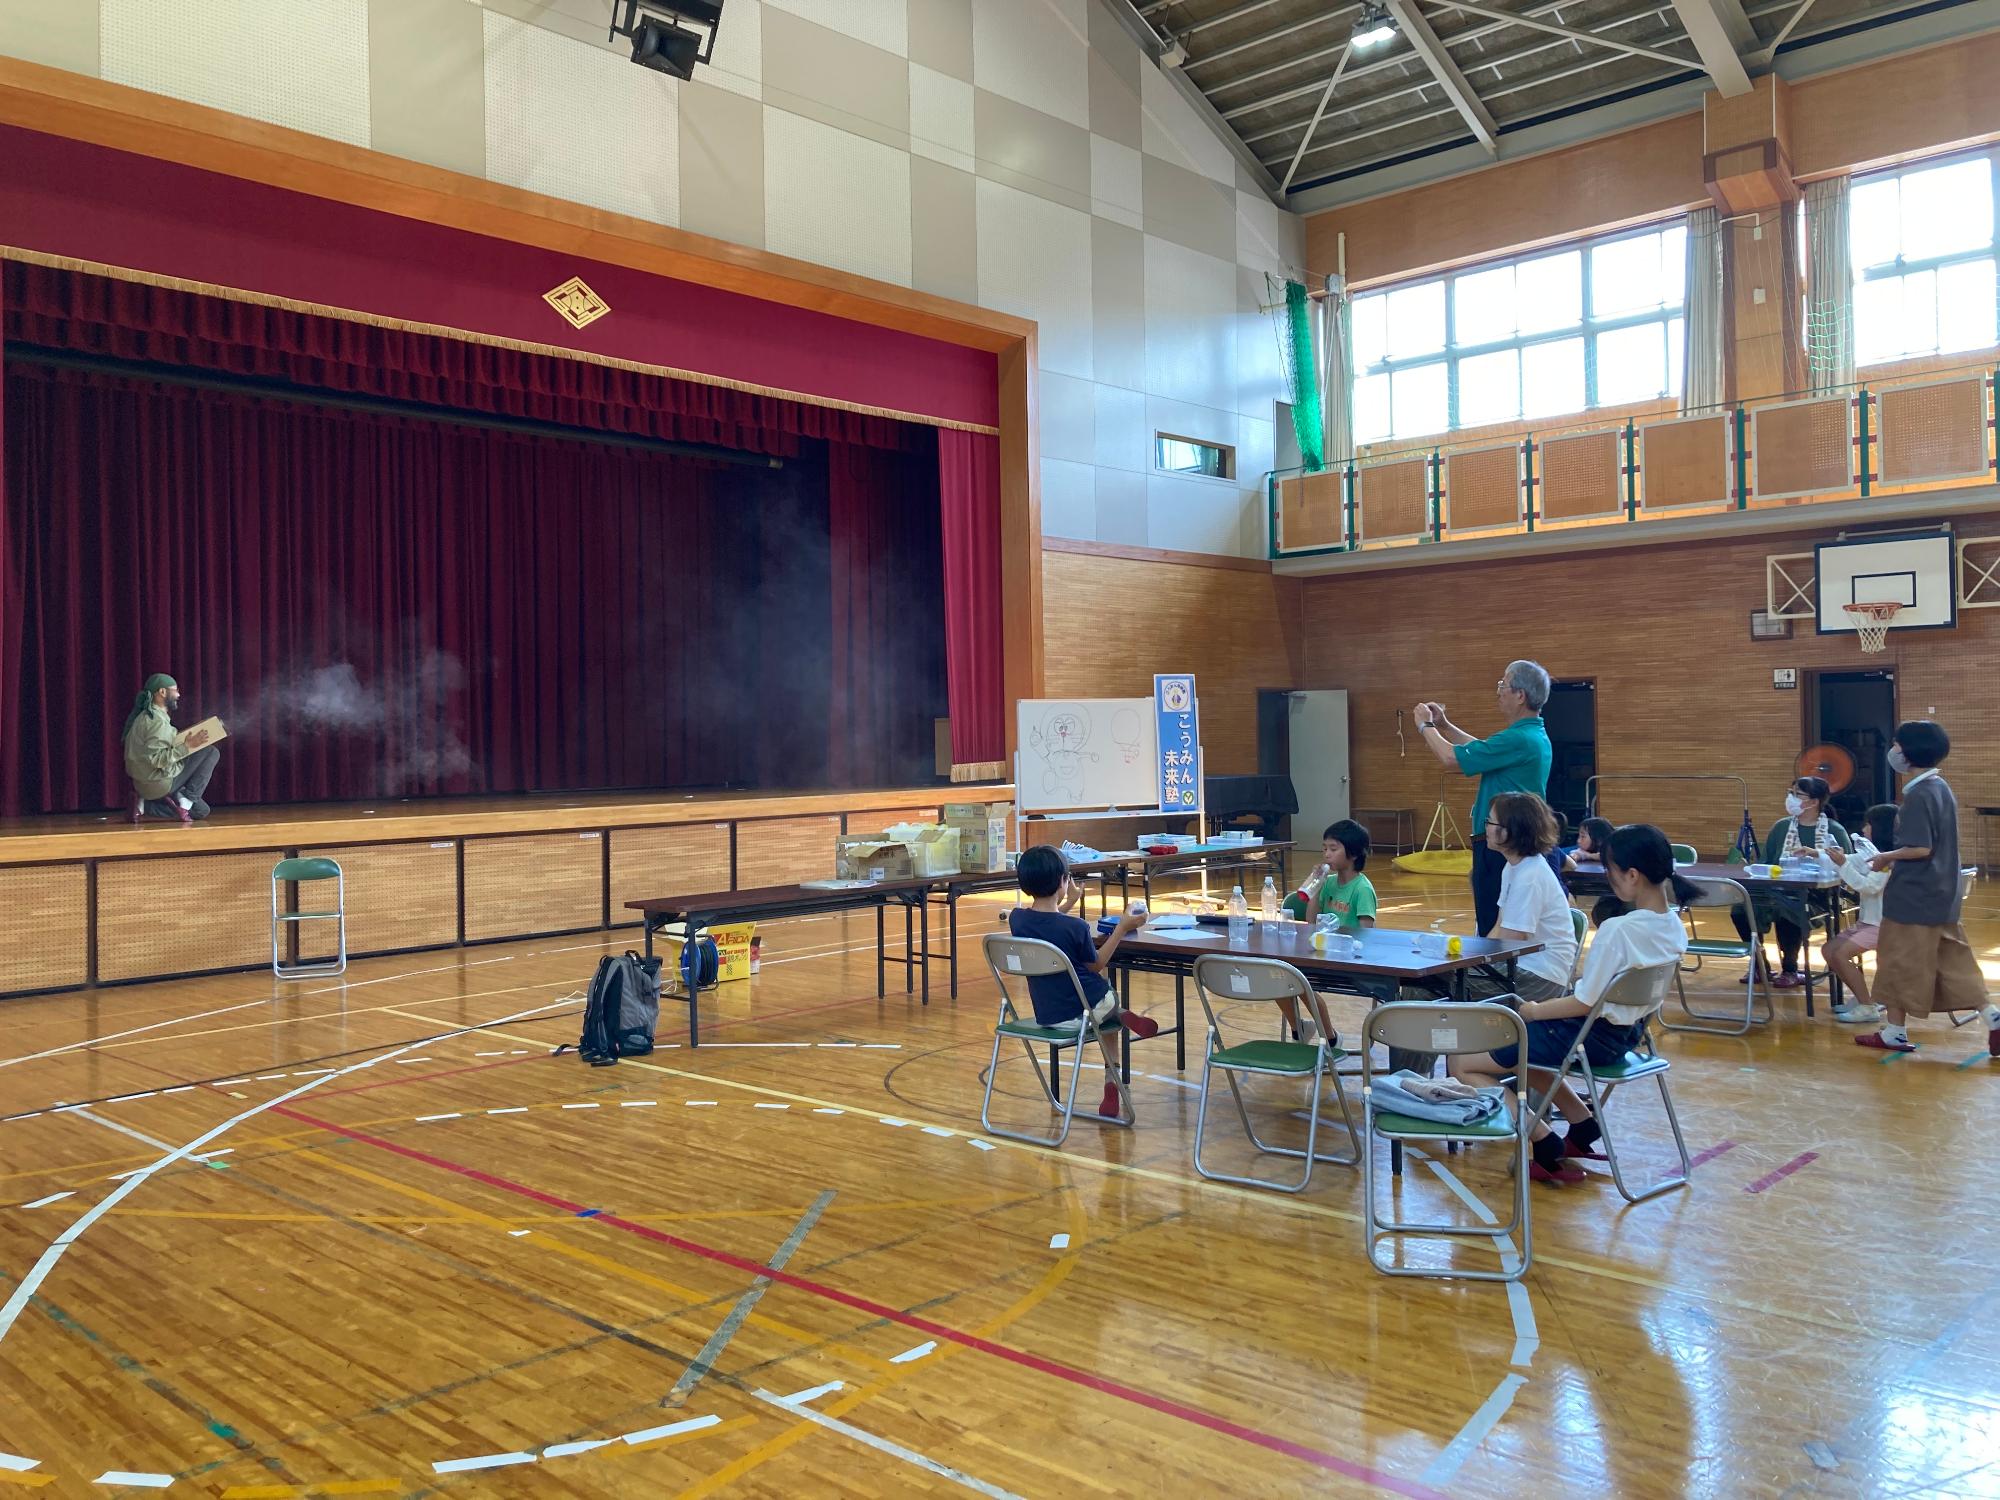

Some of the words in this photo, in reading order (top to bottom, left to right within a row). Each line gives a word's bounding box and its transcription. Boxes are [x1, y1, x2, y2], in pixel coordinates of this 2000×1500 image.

[1164, 750, 1179, 804] 未来塾
[1178, 713, 1194, 784] こうみん
